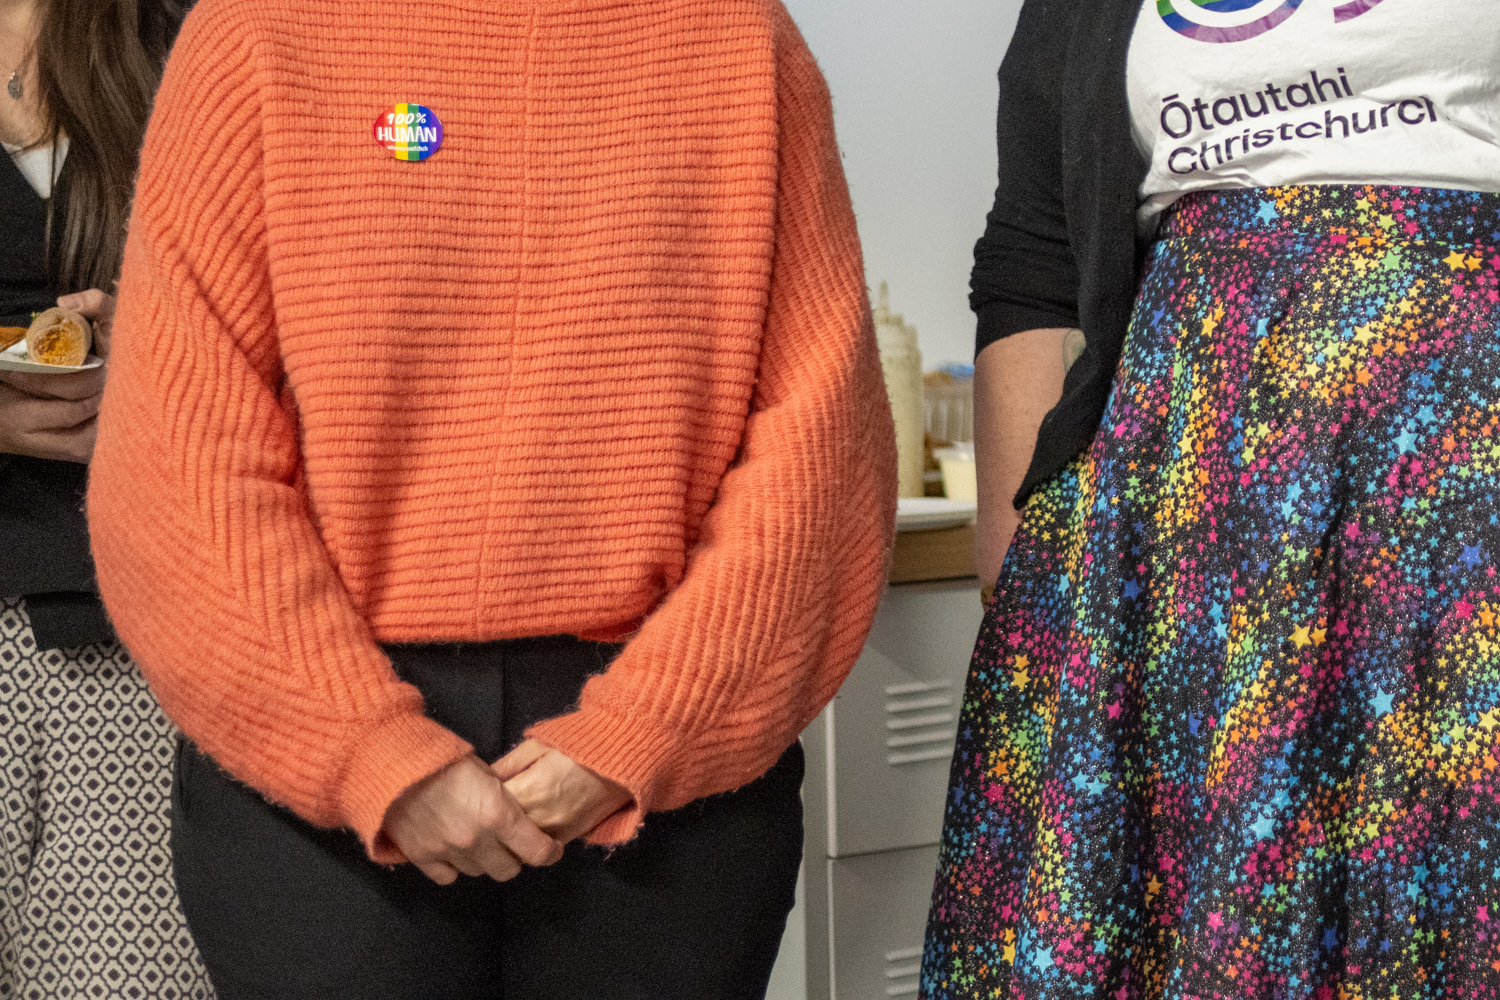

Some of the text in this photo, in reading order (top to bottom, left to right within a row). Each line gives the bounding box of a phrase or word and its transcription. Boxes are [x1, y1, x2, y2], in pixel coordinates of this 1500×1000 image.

[1160, 66, 1354, 139] Ōtautahi
[387, 112, 427, 125] 100%
[378, 127, 437, 142] HUMAN
